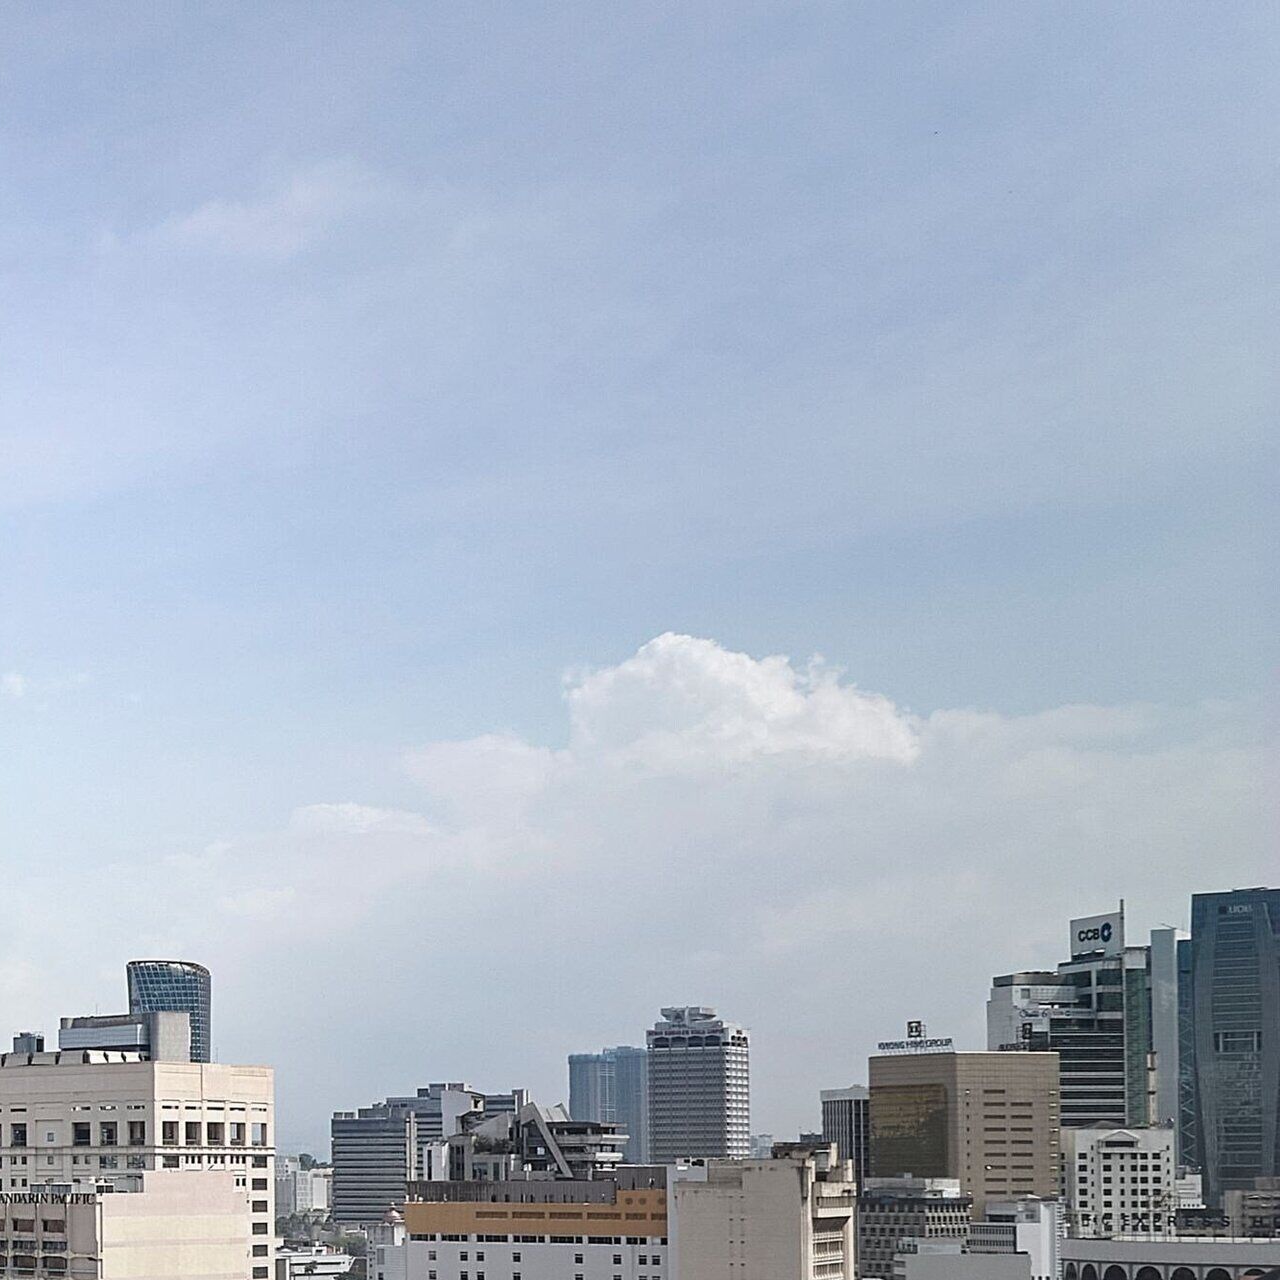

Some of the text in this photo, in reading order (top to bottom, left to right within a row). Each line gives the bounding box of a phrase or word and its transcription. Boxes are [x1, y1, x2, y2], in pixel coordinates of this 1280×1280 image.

[1078, 928, 1100, 942] CCB
[51, 1193, 96, 1205] PACIFIC
[1123, 1215, 1231, 1227] EXPRESS
